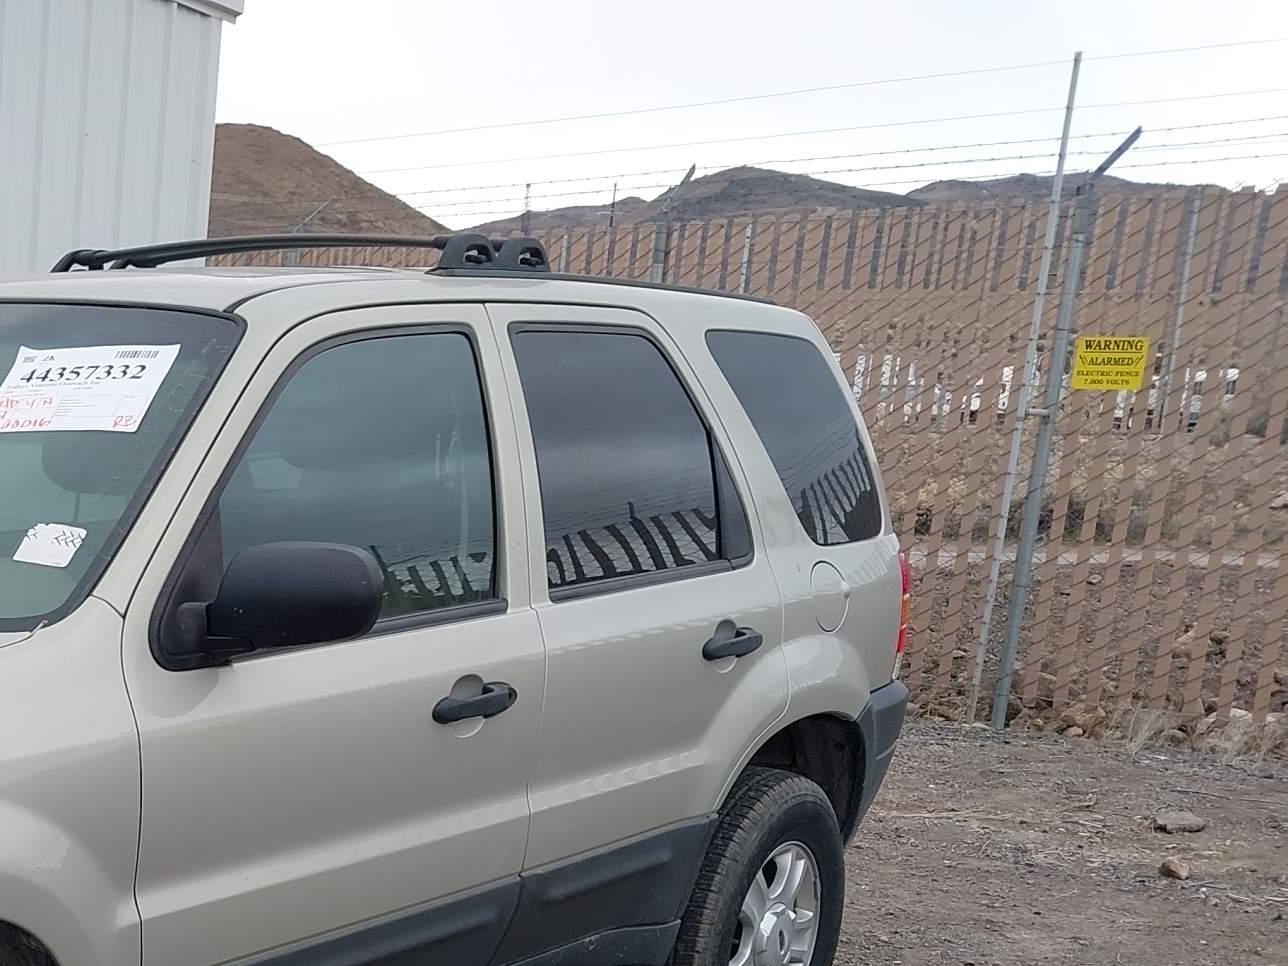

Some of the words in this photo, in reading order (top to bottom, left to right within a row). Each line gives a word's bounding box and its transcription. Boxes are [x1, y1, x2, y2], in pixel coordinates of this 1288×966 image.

[1084, 339, 1145, 351] WARNING
[1088, 356, 1134, 366] ALARMED
[20, 364, 147, 383] 44357332
